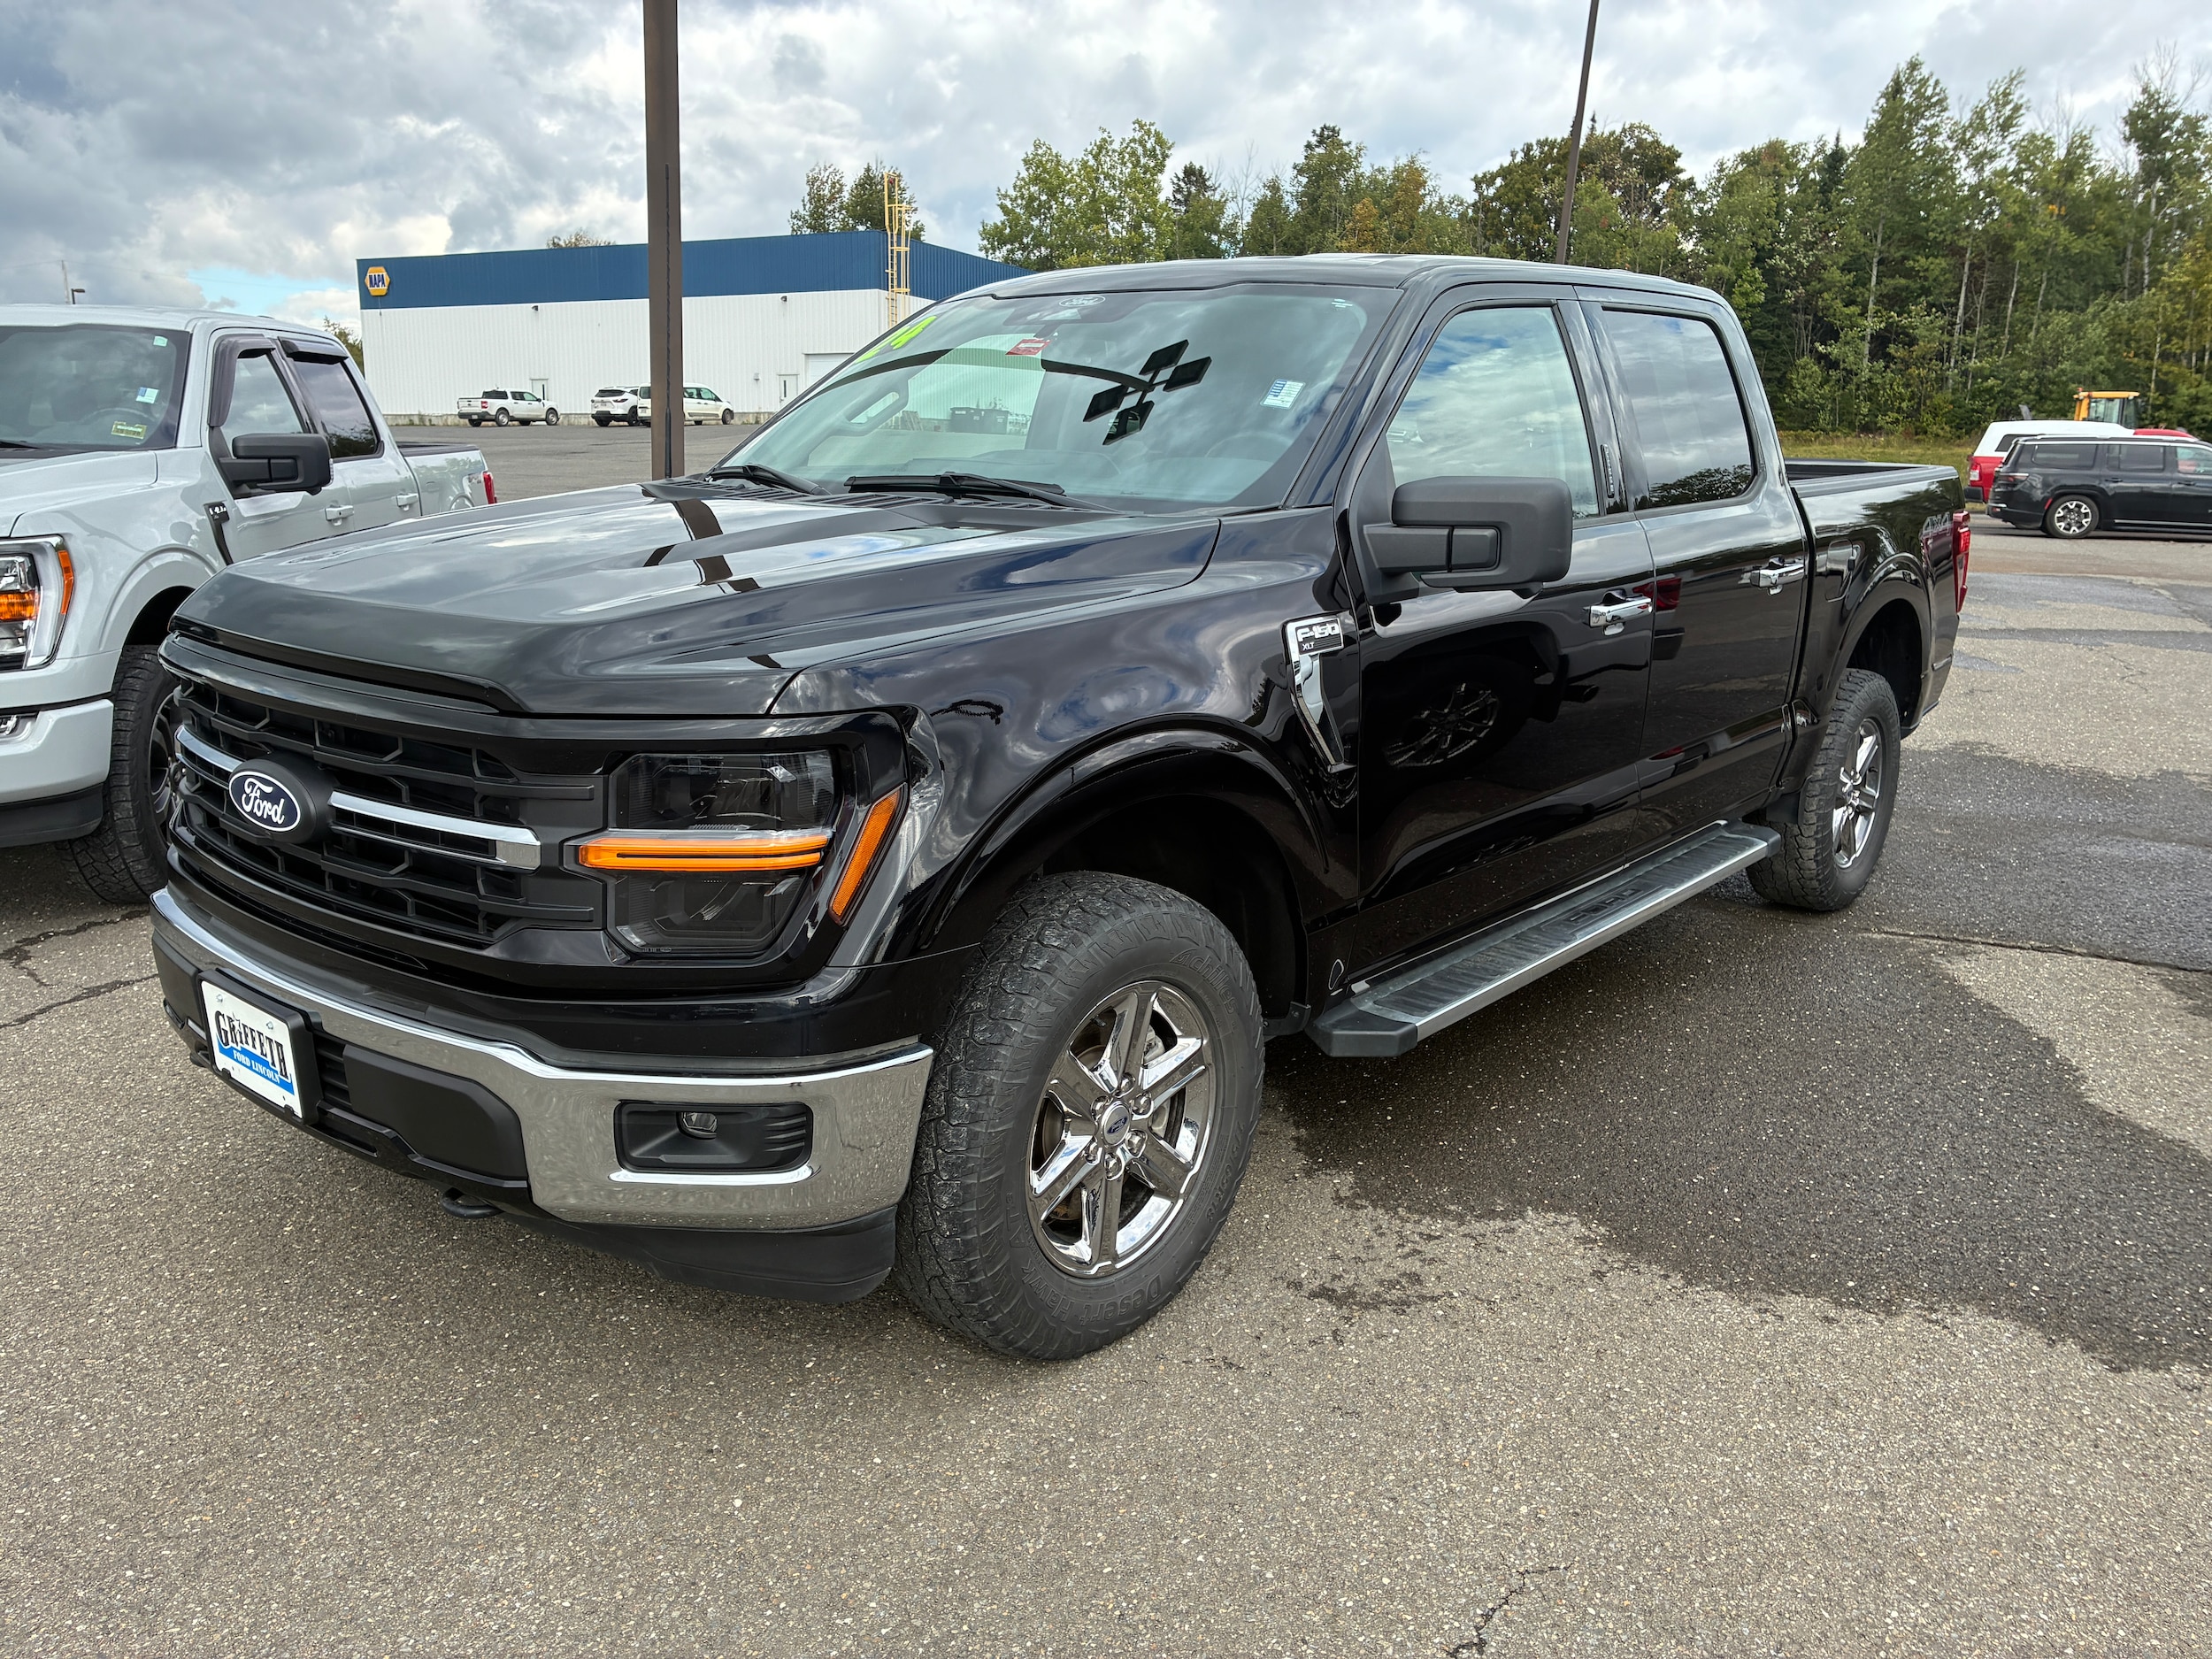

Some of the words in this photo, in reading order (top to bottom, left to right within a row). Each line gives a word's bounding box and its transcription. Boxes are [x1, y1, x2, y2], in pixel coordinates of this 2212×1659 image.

[368, 273, 386, 288] NAPA
[1296, 623, 1340, 642] F-150
[1302, 641, 1315, 651] XLT
[241, 777, 285, 825] Ford
[1169, 948, 1238, 1015] Achilles
[233, 1049, 251, 1067] FORD
[251, 1059, 280, 1084] LINCOLN
[1021, 1259, 1076, 1322] Hawk
[1079, 1274, 1162, 1326] Desert
